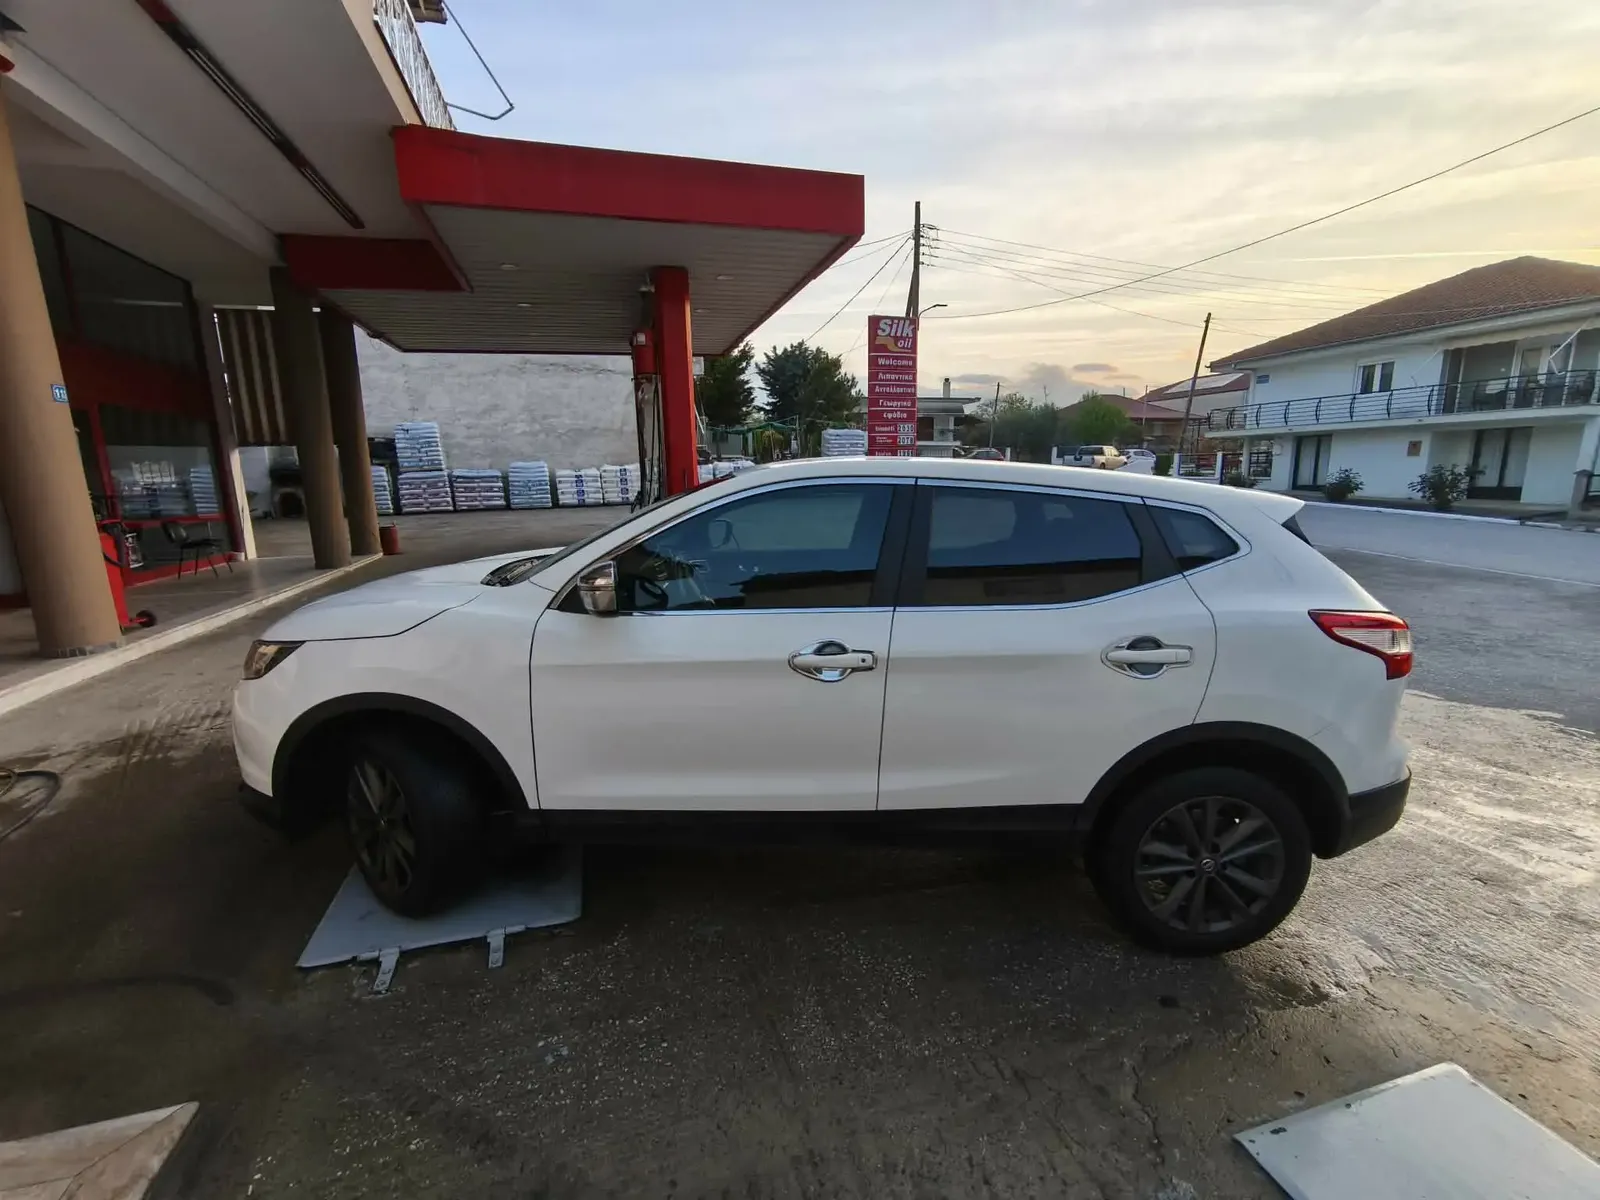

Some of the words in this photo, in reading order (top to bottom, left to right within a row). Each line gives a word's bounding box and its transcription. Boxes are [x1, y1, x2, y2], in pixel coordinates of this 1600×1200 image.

[877, 319, 914, 337] Silk
[898, 338, 912, 348] oil
[878, 358, 912, 366] Welcome
